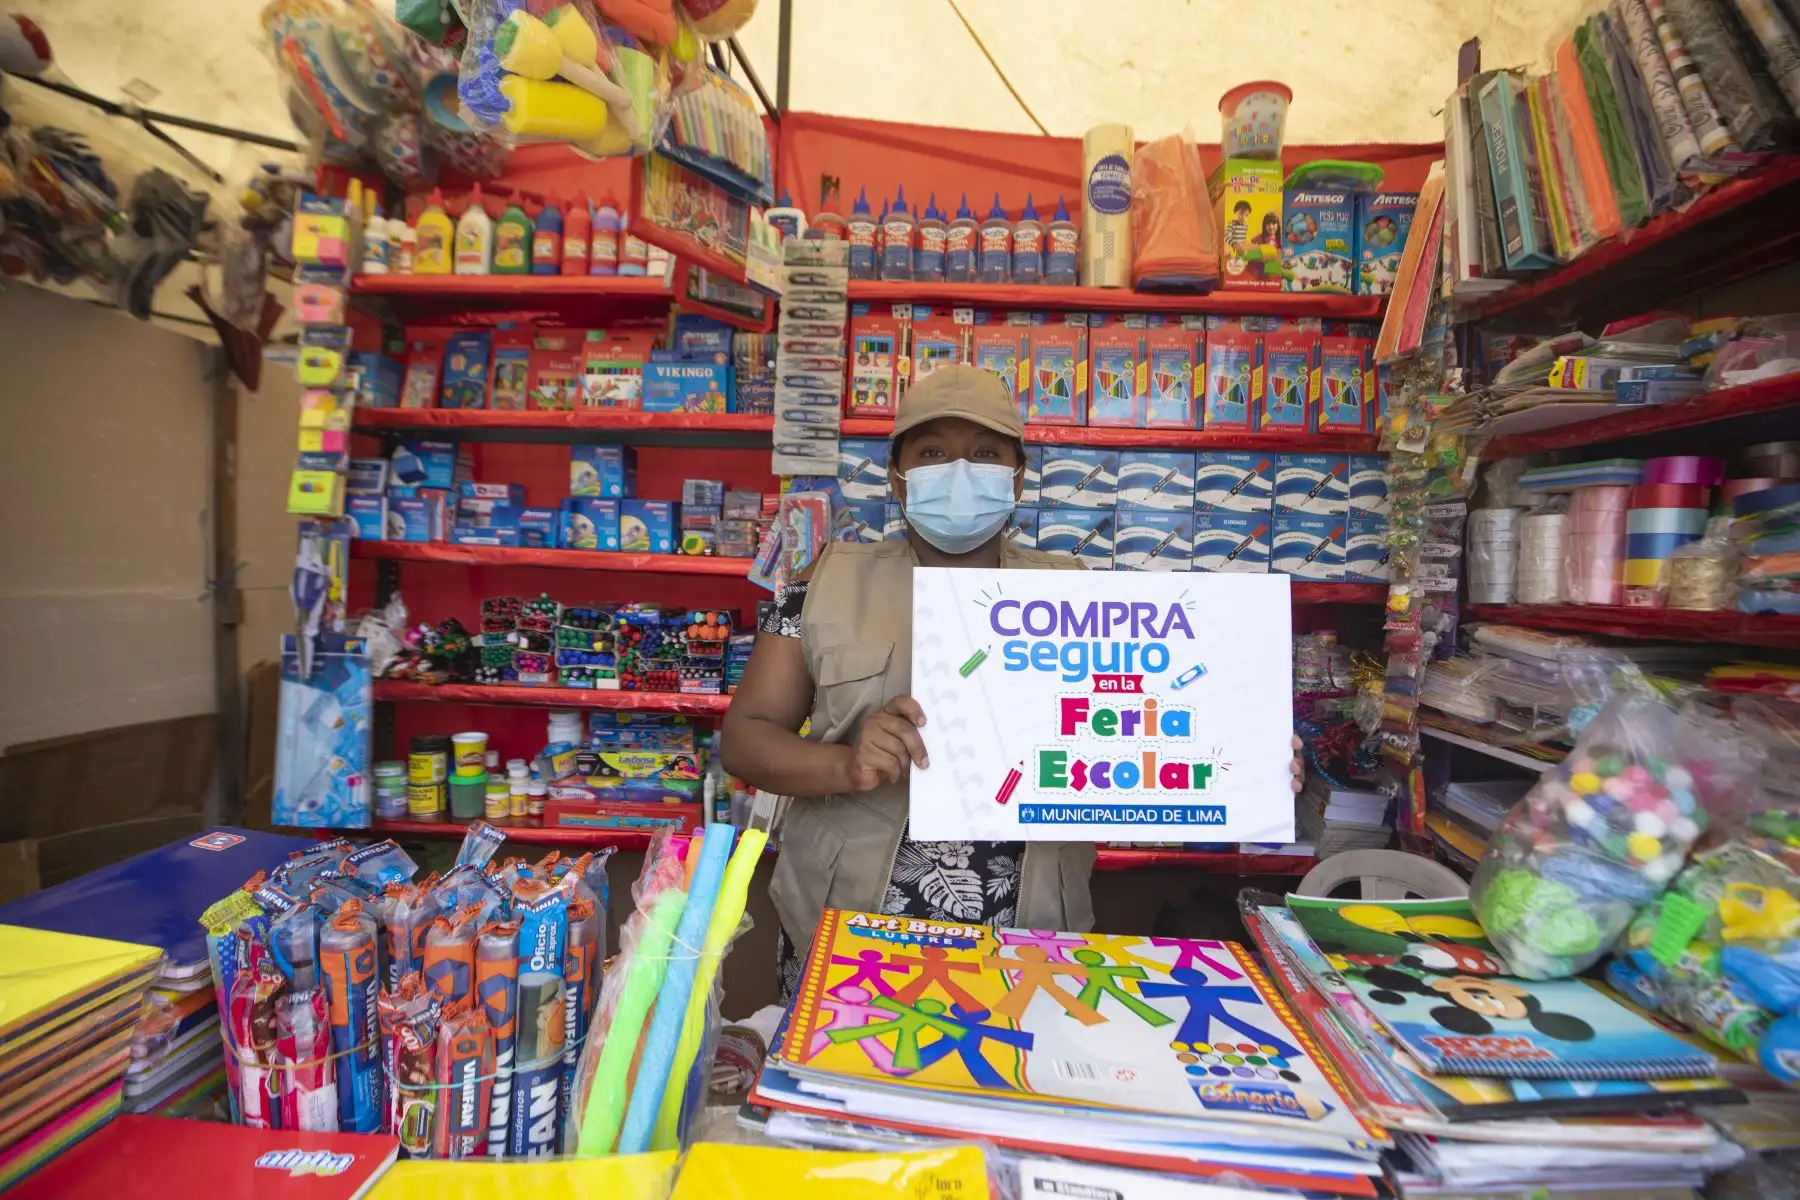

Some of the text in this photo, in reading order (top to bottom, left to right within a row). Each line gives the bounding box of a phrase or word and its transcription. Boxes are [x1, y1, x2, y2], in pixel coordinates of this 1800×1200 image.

[1294, 193, 1345, 204] ARTESCO
[657, 366, 713, 377] VIKINGO
[989, 599, 1196, 640] COMPRA
[1003, 639, 1171, 683] seguro
[1099, 676, 1136, 691] en la
[1060, 697, 1192, 737] Feria
[1038, 750, 1213, 792] Escolar
[1041, 808, 1224, 823] MUNICIPALIDAD DE LIMA
[845, 913, 985, 940] Art Book
[871, 930, 953, 945] LUSTRE
[530, 924, 547, 971] Oficio
[546, 961, 555, 970] 5
[564, 987, 577, 1064] VINIFAN
[461, 1060, 476, 1128] VINIFAN
[515, 1089, 525, 1153] cuadernos
